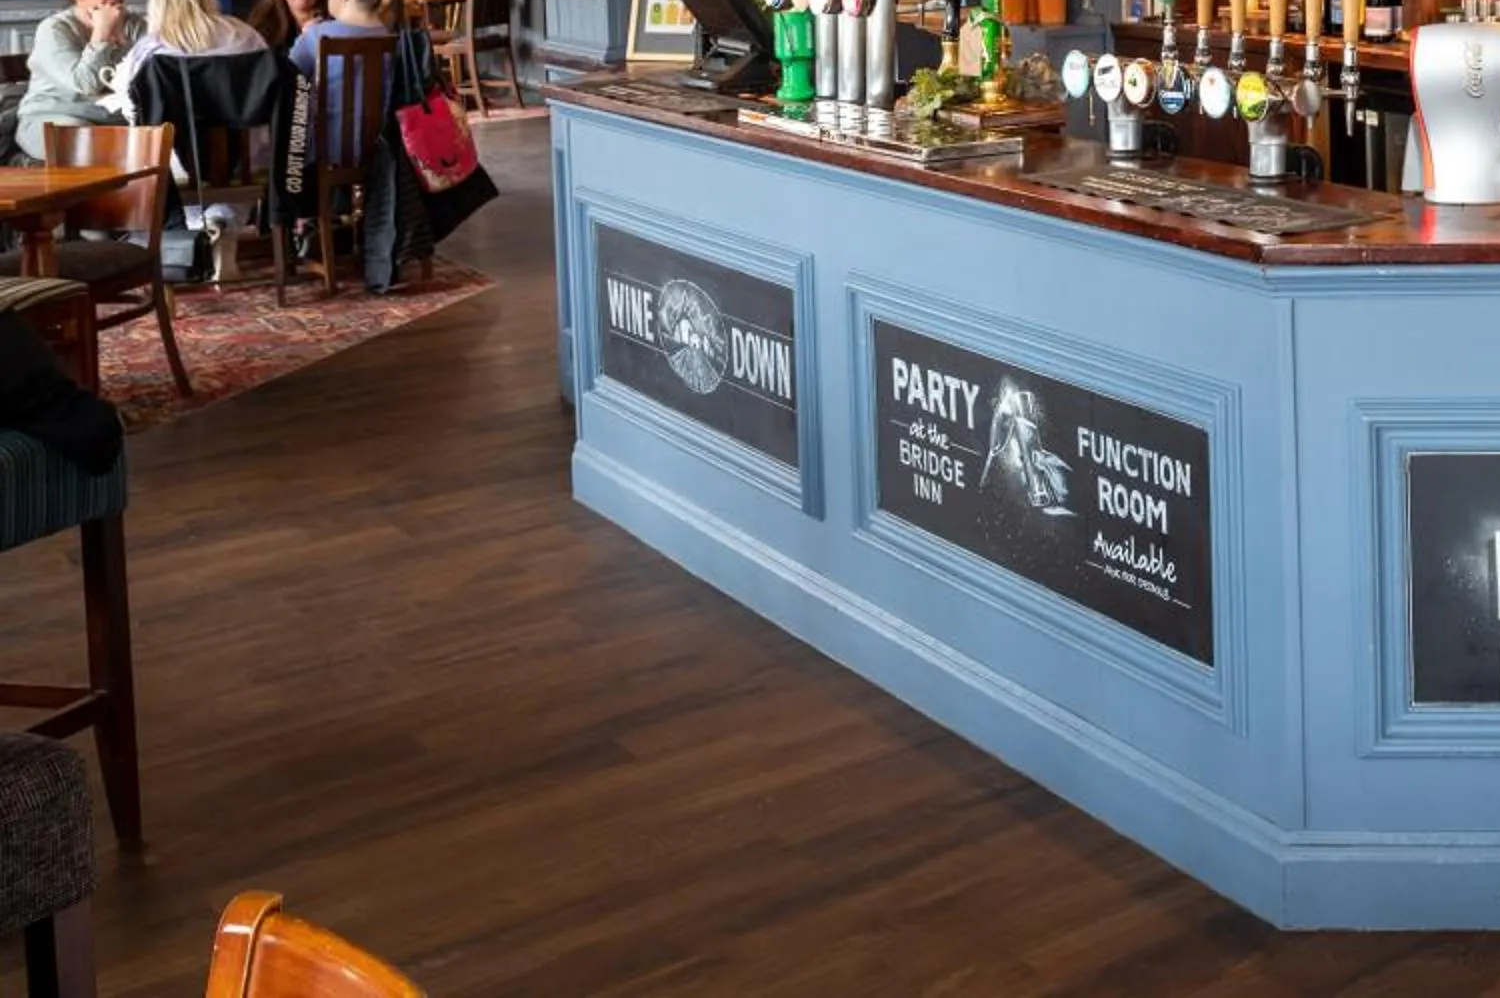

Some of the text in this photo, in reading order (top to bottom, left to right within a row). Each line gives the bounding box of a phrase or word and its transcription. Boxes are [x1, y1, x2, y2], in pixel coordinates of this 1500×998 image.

[286, 153, 304, 177] PUT
[607, 277, 792, 400] WINE DOWN
[892, 357, 980, 430] PARTY
[908, 418, 950, 451] at the
[899, 438, 965, 490] BRIDGE
[913, 473, 943, 505] INN
[1077, 426, 1192, 498] FUNCTION
[1097, 475, 1169, 535] ROOM
[1093, 530, 1178, 584] Available
